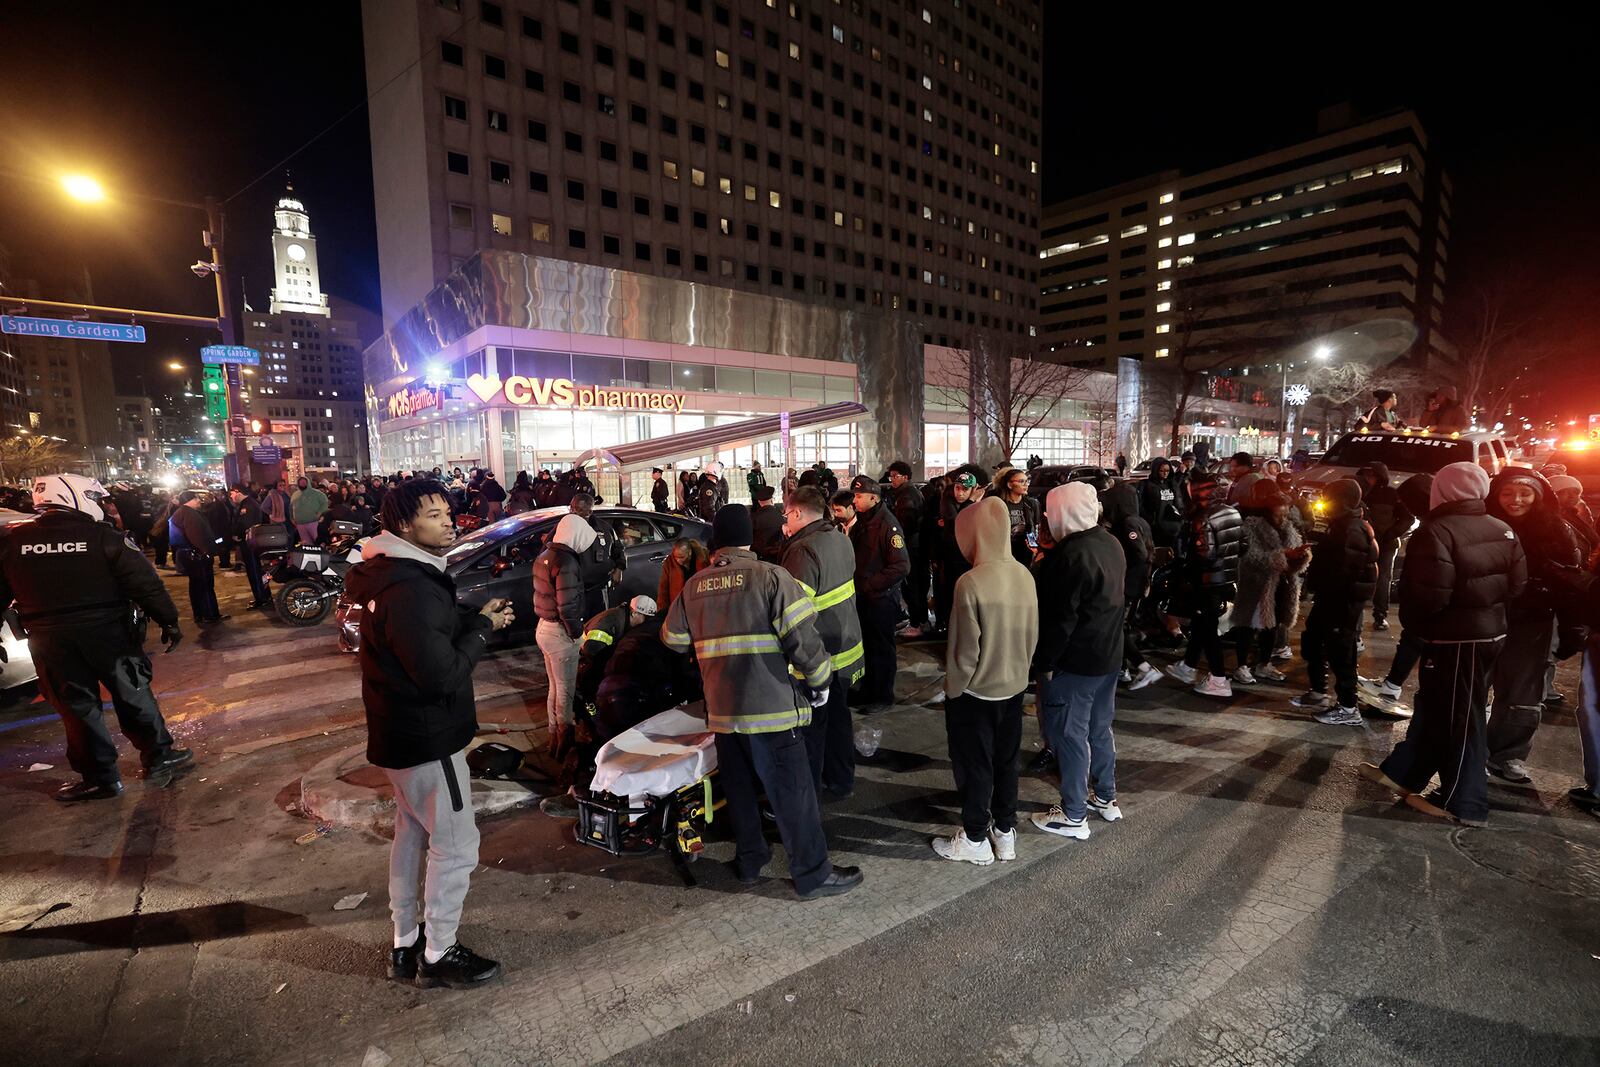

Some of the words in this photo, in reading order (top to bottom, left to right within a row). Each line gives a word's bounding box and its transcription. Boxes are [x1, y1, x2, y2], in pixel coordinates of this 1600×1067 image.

[8, 320, 60, 336] Spring
[67, 324, 120, 337] Garden
[126, 328, 139, 339] St
[202, 348, 226, 356] SPRING
[227, 349, 252, 358] GARDEN
[395, 388, 410, 417] CVS
[410, 389, 439, 417] pharmacy
[504, 375, 575, 405] CVS
[578, 385, 686, 415] pharmacy
[1391, 436, 1458, 449] LIMIT
[21, 542, 88, 555] POLICE
